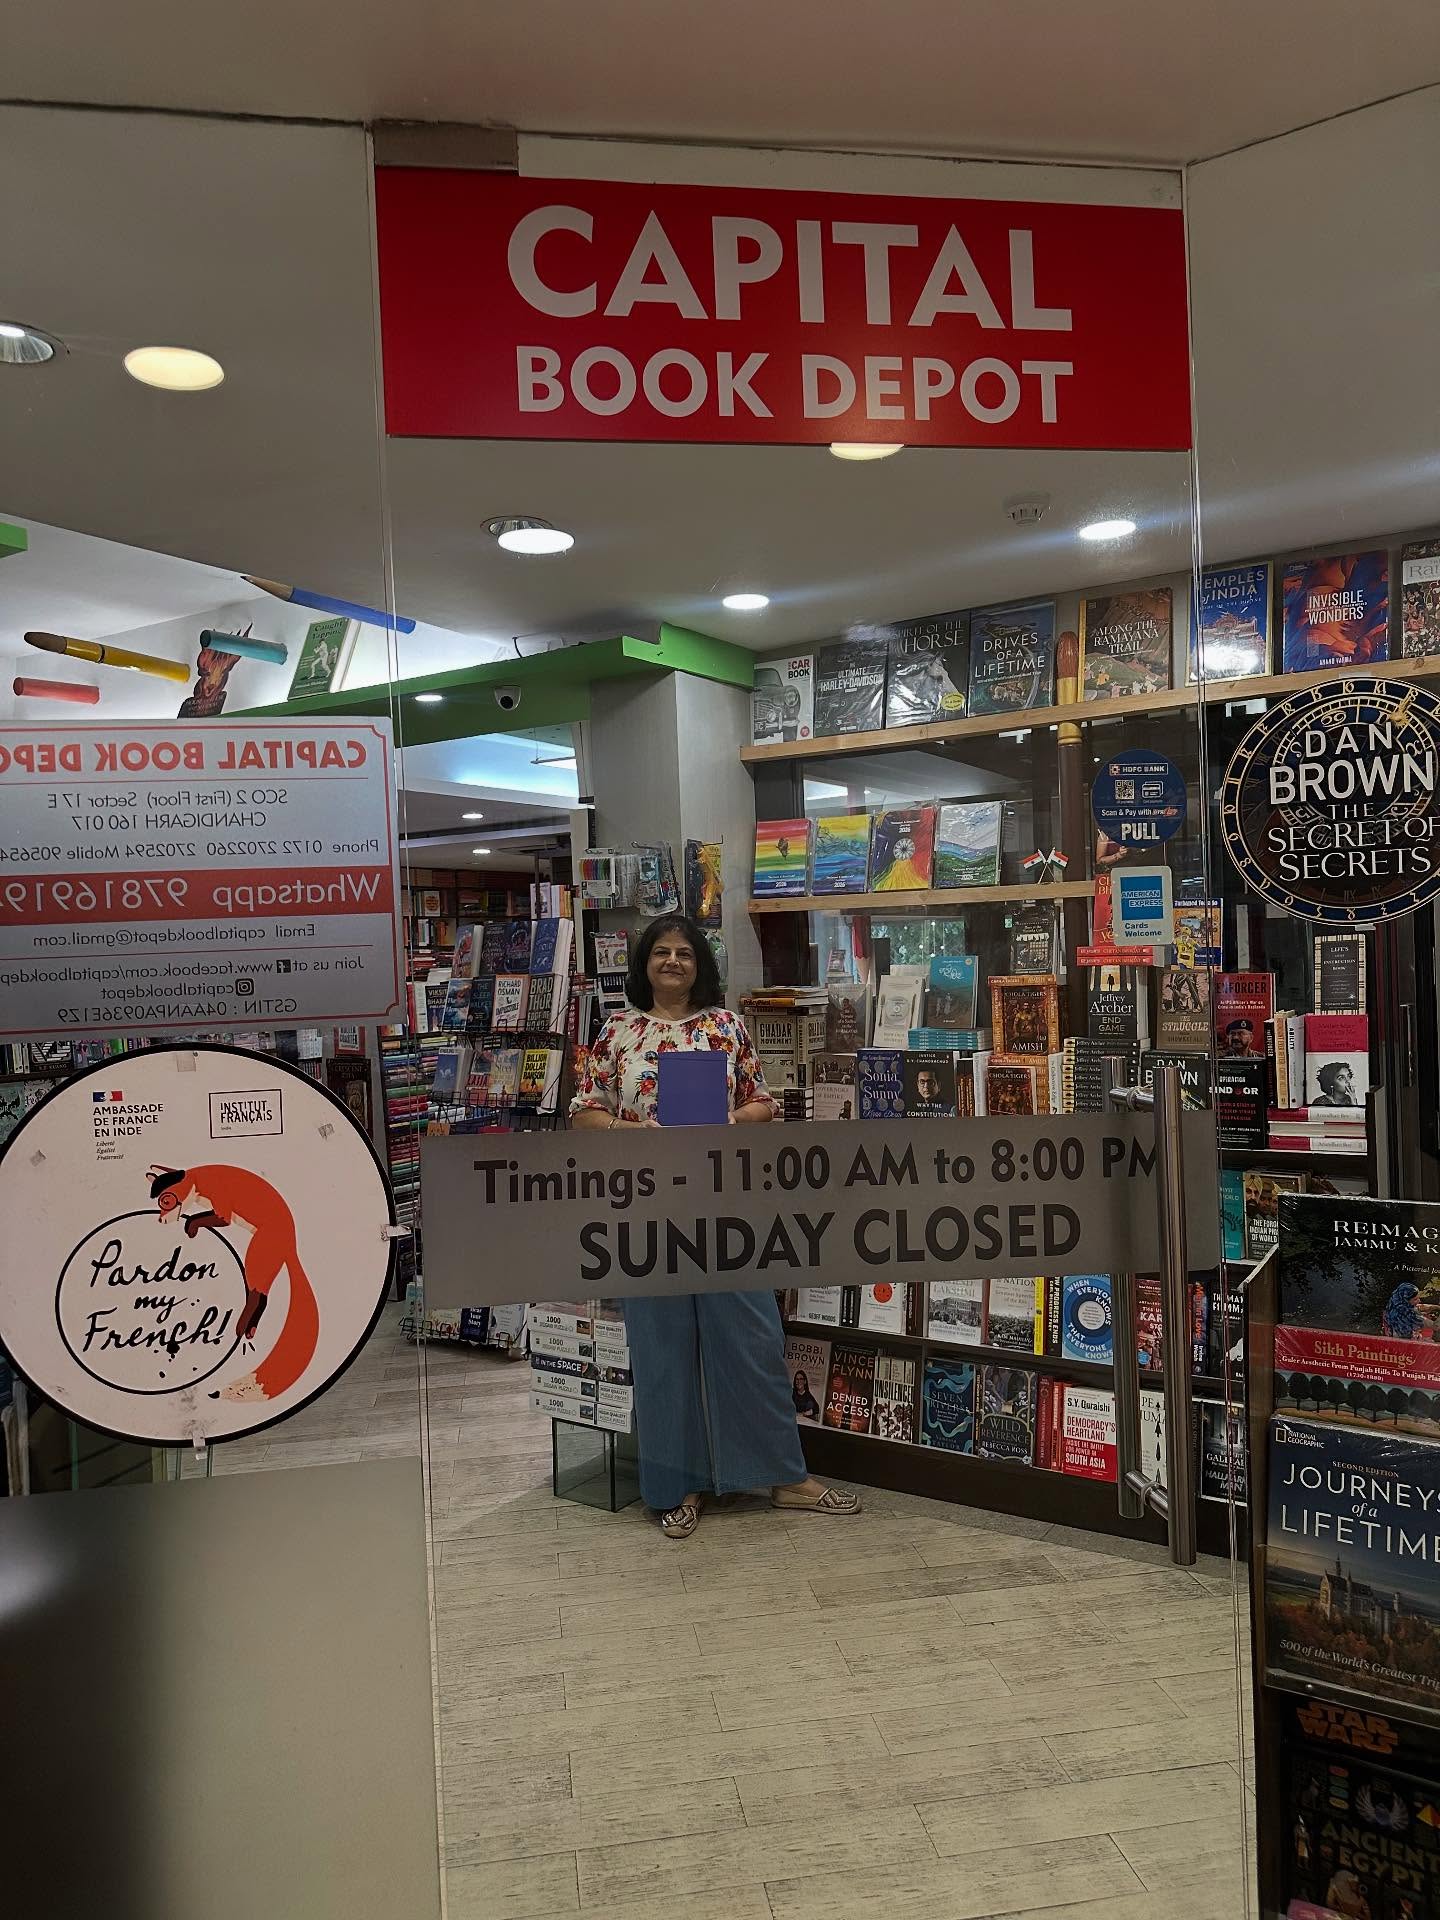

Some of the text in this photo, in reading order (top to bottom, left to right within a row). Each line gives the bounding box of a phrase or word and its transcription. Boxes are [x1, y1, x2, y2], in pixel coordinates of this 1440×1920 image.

[507, 204, 1072, 332] CAPITAL
[516, 344, 1074, 424] BOOK DEPOT
[1200, 570, 1265, 590] EMPLES
[1212, 584, 1258, 601] INDIA
[1308, 589, 1364, 609] INVISIBLE
[1308, 606, 1364, 626] WONDERS
[1094, 628, 1159, 647] RAMAYANA
[1096, 624, 1133, 636] ALONG
[904, 629, 964, 653] HORSE
[983, 632, 1038, 652] DRIVES
[1108, 640, 1144, 654] TRAIL
[996, 648, 1024, 661] OF A
[792, 659, 810, 670] CAR
[838, 666, 867, 679] ULTIMATE
[974, 656, 1046, 678] LIFETIME
[788, 668, 810, 679] BOOK
[1305, 722, 1393, 758] DAN
[1144, 765, 1165, 773] BANK
[1270, 750, 1434, 806] BROWN
[1101, 808, 1118, 817] Scan
[1124, 808, 1137, 817] Pay
[1136, 808, 1152, 816] with
[1326, 802, 1375, 820] THE
[1120, 822, 1161, 841] PULL
[1268, 816, 1440, 854] SECRET OF
[1279, 846, 1432, 882] SECRETS
[1122, 890, 1160, 898] AMERICAN
[1130, 900, 1164, 908] EXPRESS
[1124, 922, 1149, 930] Cards
[1125, 930, 1162, 938] Welcome
[496, 988, 520, 996] OSMAN
[530, 976, 554, 995] BRAD
[1216, 981, 1267, 994] ENFORCER
[529, 994, 552, 1010] THOR
[1098, 993, 1126, 1004] Jeffrey
[1089, 1001, 1134, 1014] Archer
[1098, 1024, 1126, 1032] GAME
[1102, 1016, 1122, 1024] END
[1162, 1021, 1209, 1032] STRUGGLE
[760, 1023, 792, 1038] GHADAR
[1012, 1042, 1044, 1052] AMISH
[1288, 1028, 1296, 1051] ABILITY
[524, 1062, 546, 1072] DOLLAR
[864, 1068, 898, 1082] Sonia
[522, 1071, 546, 1080] RANSOM
[864, 1085, 900, 1100] Sunny
[92, 1104, 164, 1116] AMBASSADE
[220, 1100, 268, 1114] INSTITUT
[94, 1114, 159, 1126] DE FRANCE
[94, 1126, 142, 1138] EN INDE
[96, 1140, 116, 1148] Liberté
[474, 1154, 656, 1210] Timings
[706, 1146, 830, 1195] 11:00
[844, 1142, 918, 1188] AM
[934, 1144, 976, 1184] to
[990, 1134, 1084, 1182] 8:00
[1104, 1134, 1158, 1179] PM
[580, 1202, 1082, 1281] SUNDAY CLOSED
[1334, 1236, 1440, 1254] JAMMU & K
[90, 1238, 220, 1288] Pardon
[1066, 1278, 1090, 1293] WHEN
[134, 1294, 188, 1323] my
[1095, 1296, 1112, 1326] KNOWS
[546, 1315, 562, 1324] 1000
[82, 1306, 234, 1353] French!
[1067, 1322, 1086, 1342] THAT
[791, 1342, 823, 1355] BOBBI
[1066, 1332, 1107, 1352] EVERYONE
[787, 1352, 825, 1366] BROWN
[834, 1351, 875, 1368] VINCE
[1314, 1340, 1414, 1368] Sikh Paintings
[556, 1360, 582, 1372] SPACE
[832, 1363, 873, 1381] FLYNN
[1282, 1355, 1426, 1382] Guler Aesthetic From Punjab Hills To Punjab
[550, 1376, 566, 1386] 1000
[549, 1398, 564, 1408] 1000
[832, 1390, 868, 1406] DENIED
[932, 1390, 964, 1404] SEVEN
[826, 1401, 870, 1418] ACCESS
[1067, 1398, 1110, 1413] S.Y. Quraishi
[990, 1416, 1022, 1432] WILD
[1066, 1416, 1116, 1433] DEMOCRACY'S
[981, 1428, 1030, 1446] REVERENCE
[1066, 1426, 1106, 1442] HEARTLAND
[1287, 1430, 1318, 1441] NATIONAL
[982, 1440, 1029, 1455] REBECCA ROSS
[1065, 1445, 1091, 1456] FOR POWER
[1288, 1436, 1326, 1450] GEOGRAPHIC
[1064, 1452, 1106, 1470] SOUTH ASIA
[1332, 1460, 1400, 1479] SECOND EDITION
[1351, 1502, 1378, 1518] of a
[1279, 1638, 1417, 1682] 500 of the World's Greatest
[1296, 1698, 1396, 1734] STAR
[1298, 1718, 1400, 1754] WARS
[1320, 1822, 1440, 1874] ANCIENT
[1338, 1844, 1424, 1892] EGYPT
